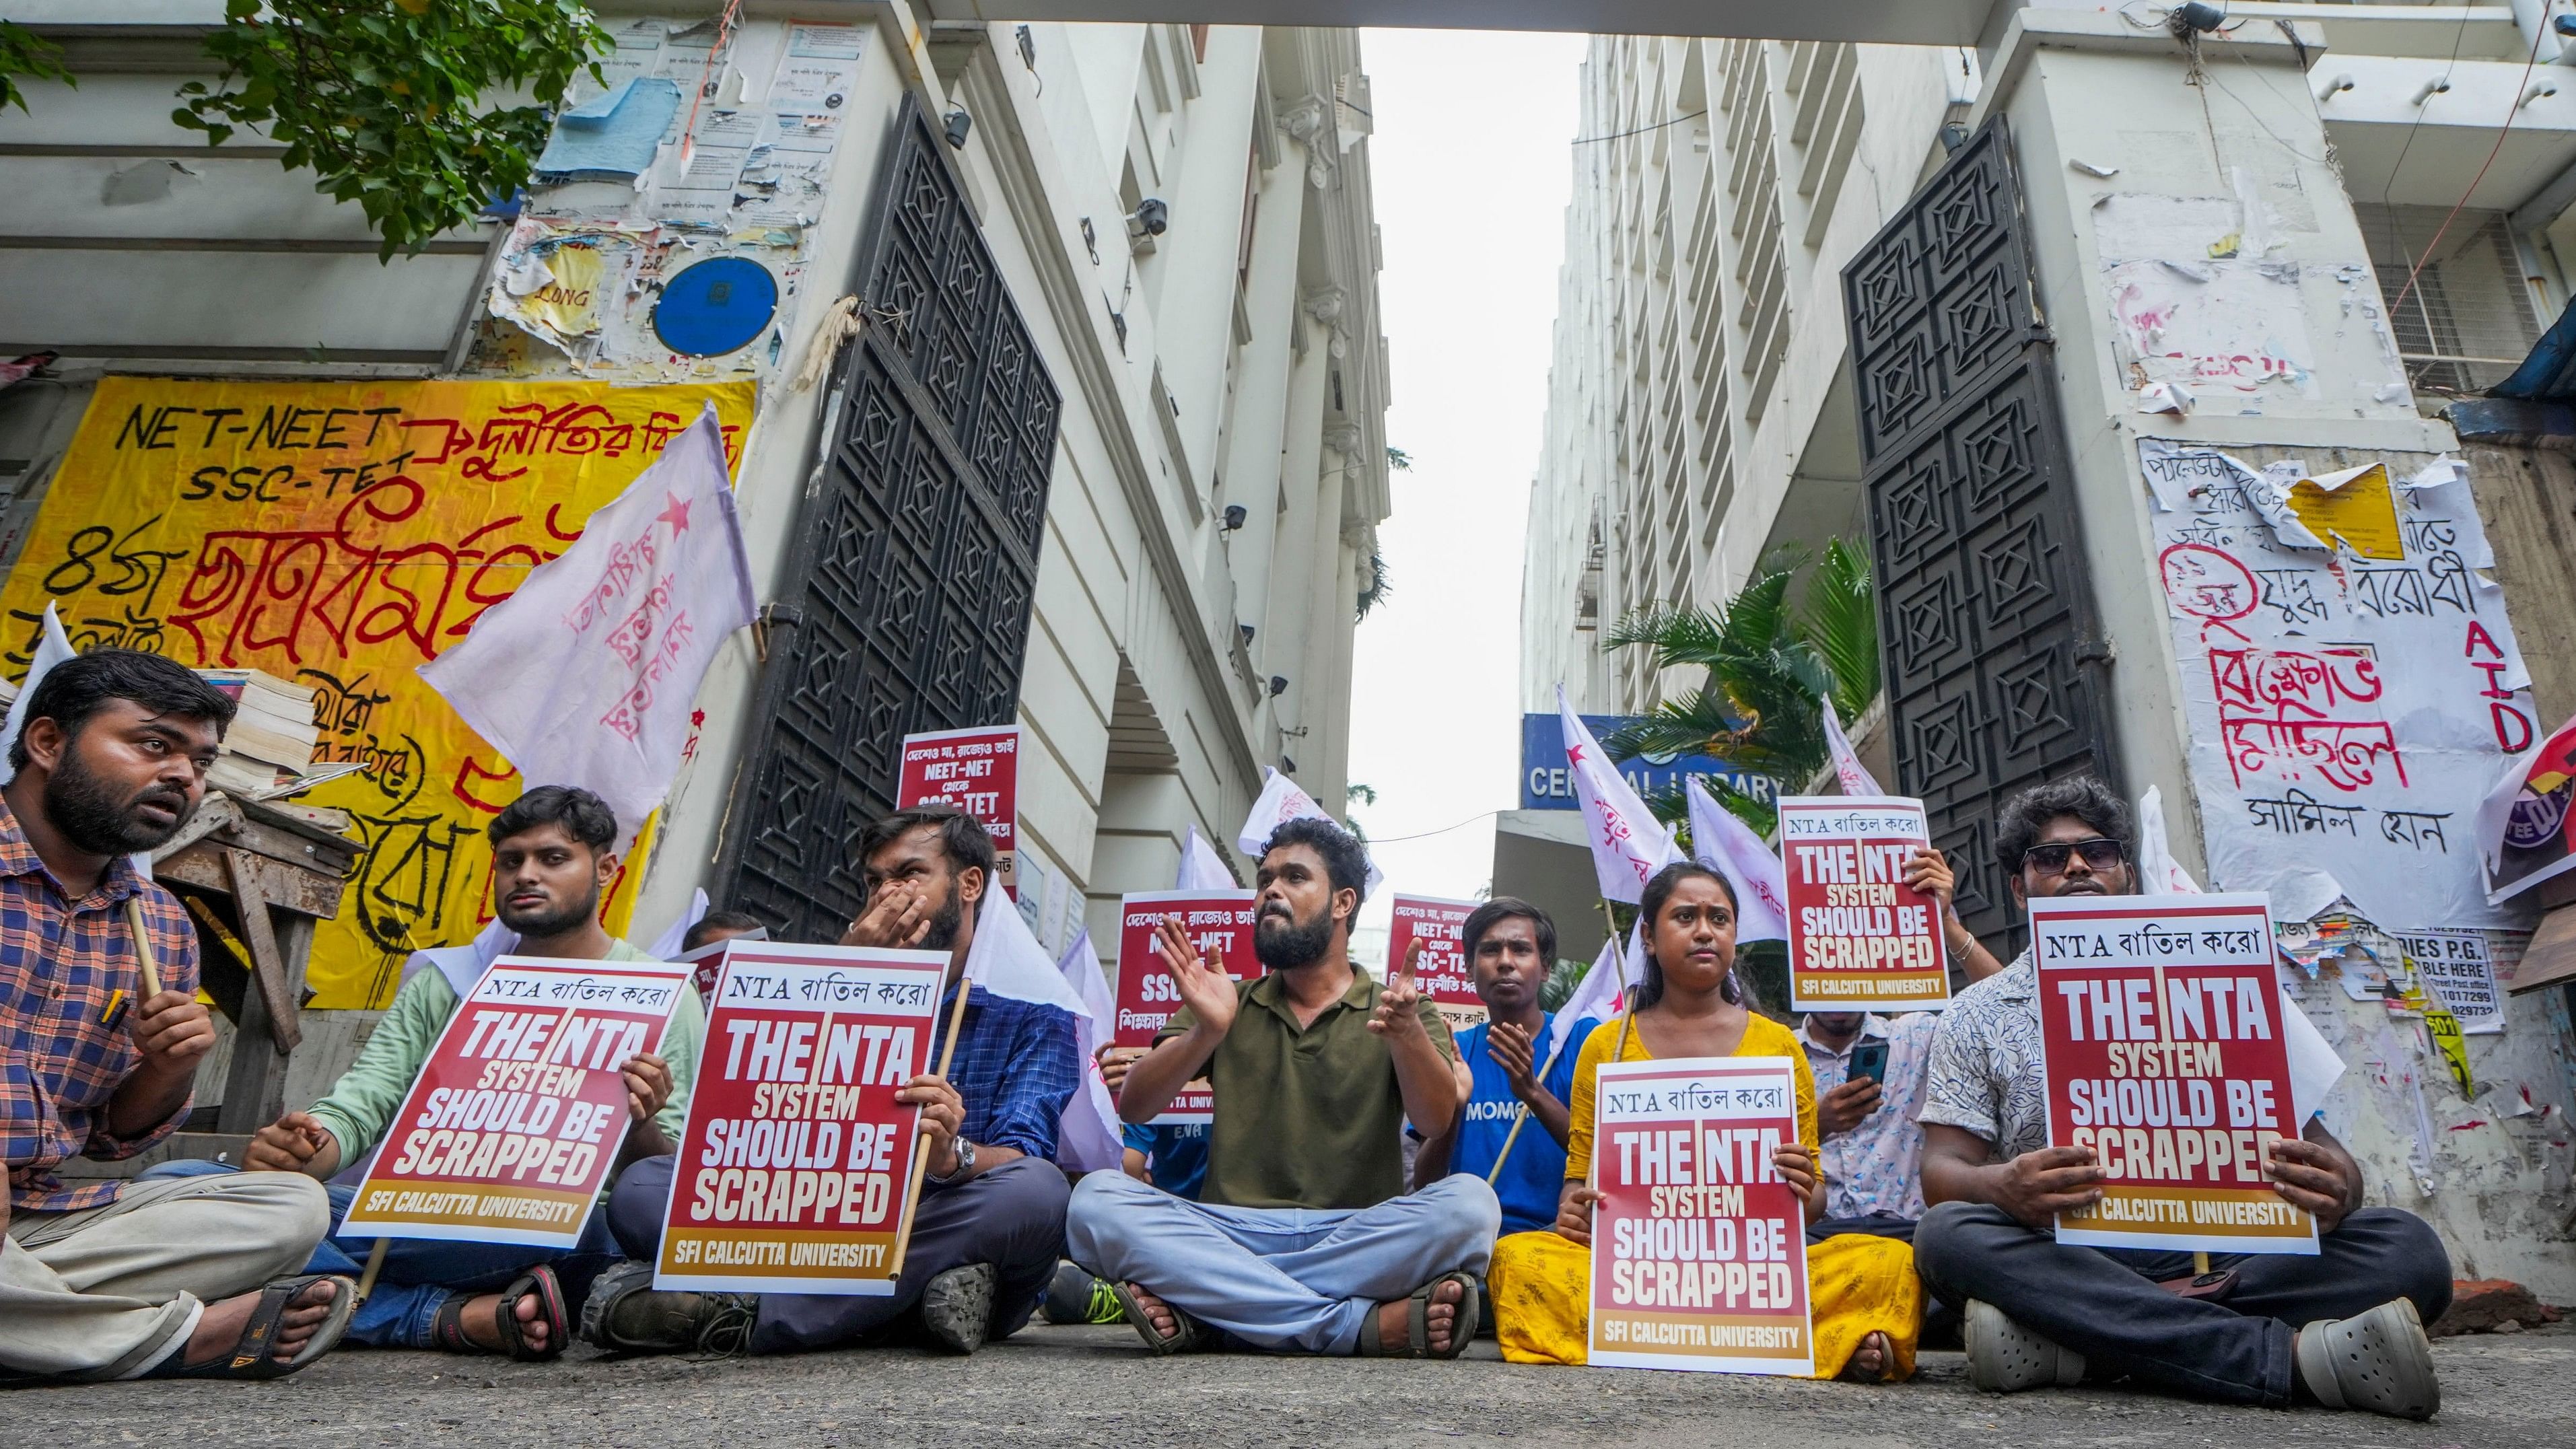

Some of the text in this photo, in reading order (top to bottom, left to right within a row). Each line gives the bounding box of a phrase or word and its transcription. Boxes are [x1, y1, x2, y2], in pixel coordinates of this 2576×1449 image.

[925, 759, 994, 781] NEET-NET
[1789, 813, 1918, 833] NTA বাতিল করো
[1796, 845, 1858, 884] THE
[1826, 884, 1897, 907] SYSTEM
[1801, 906, 1929, 936] SHOULD BE
[1803, 936, 1935, 969] SCRAPPED
[2046, 923, 2261, 959] NTA বাতিল করো
[2398, 938, 2482, 960] DIES P.G.
[1803, 979, 1940, 994] SFI CALCUTTA UNIVERSITY
[2451, 962, 2485, 978] HERE
[483, 979, 672, 1008] NTA বাতিল করো
[729, 975, 791, 1000] NTA
[801, 971, 871, 1003] বাতিল
[878, 982, 931, 1007] করো
[2441, 991, 2491, 1002] 1017299
[2058, 978, 2155, 1042] THE
[2167, 977, 2272, 1040] NTA
[2451, 1005, 2493, 1016] 029732
[460, 1011, 650, 1072] THE NTA
[724, 1019, 915, 1086] THE NTA
[2108, 1042, 2223, 1078] SYSTEM
[477, 1060, 587, 1099] SYSTEM
[417, 1088, 615, 1142] SHOULD BE
[752, 1082, 860, 1121] SYSTEM
[1609, 1083, 1783, 1114] NTA বাতিল করো
[2068, 1079, 2278, 1128] SHOULD BE
[393, 1129, 598, 1187] SCRAPPED
[702, 1119, 897, 1171] SHOULD BE
[1614, 1127, 1786, 1185] THE NTA
[365, 1191, 579, 1224] SFI CALCUTTA UNIVERSITY
[690, 1168, 891, 1224] SCRAPPED
[1650, 1185, 1745, 1217] SYSTEM
[2100, 1197, 2187, 1224] CALCUTTA
[2191, 1200, 2299, 1226] UNIVERSITY
[674, 1240, 886, 1267] SFI CALCUTTA UNIVERSITY
[1613, 1218, 1787, 1261] SHOULD BE
[1612, 1260, 1793, 1309] SCRAPPED
[1605, 1320, 1799, 1348] SFI CALCUTTA UNIVERSITY
